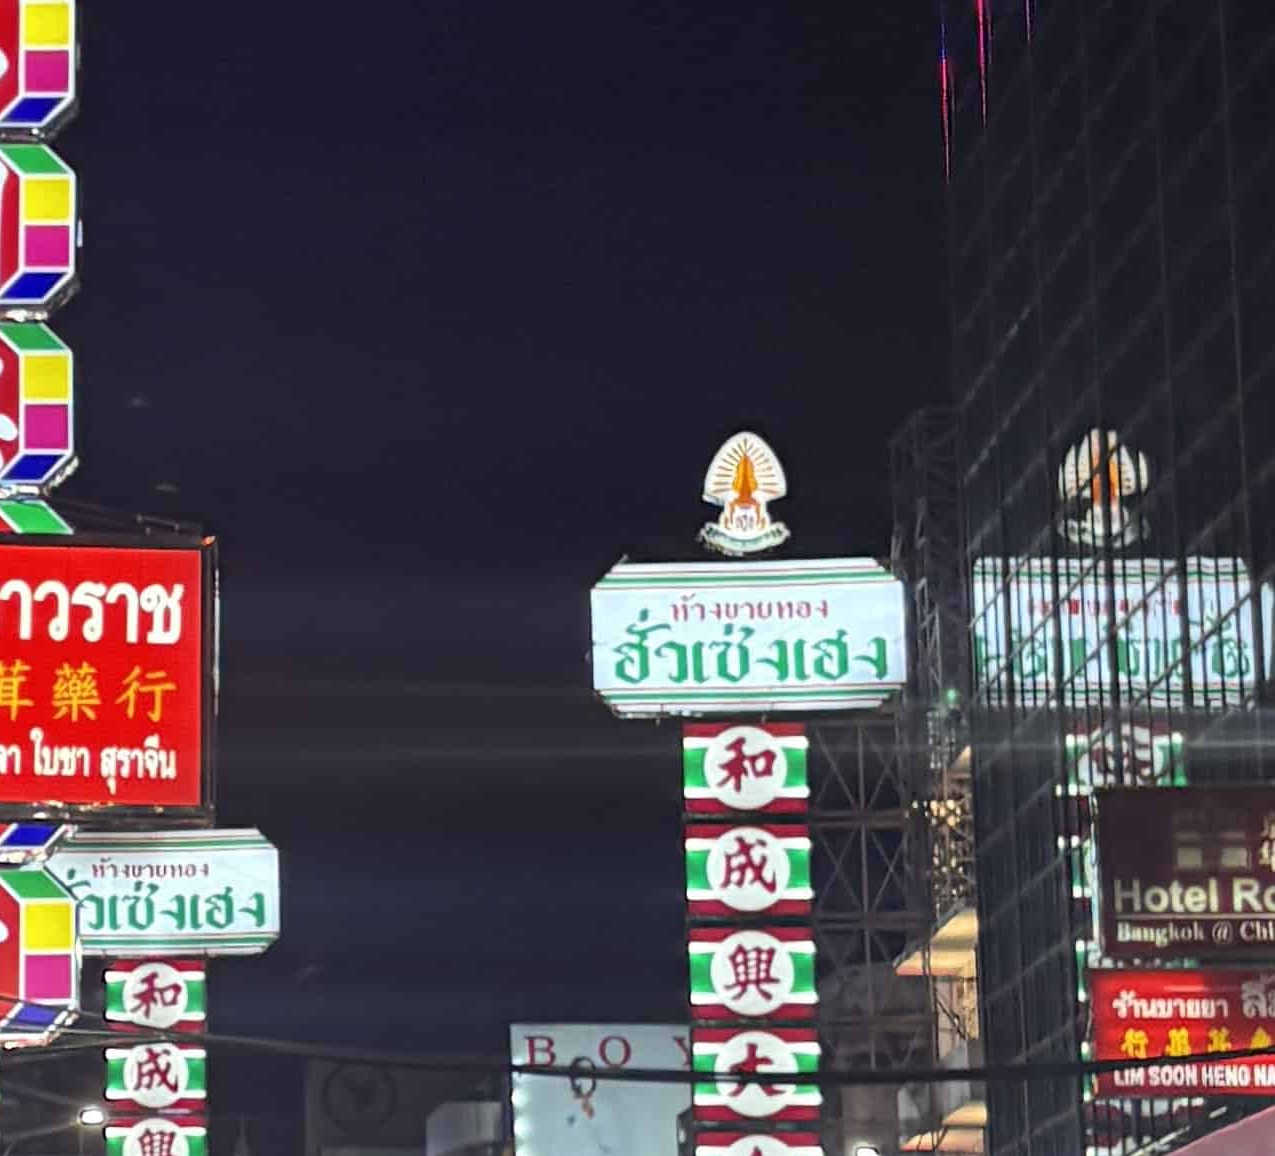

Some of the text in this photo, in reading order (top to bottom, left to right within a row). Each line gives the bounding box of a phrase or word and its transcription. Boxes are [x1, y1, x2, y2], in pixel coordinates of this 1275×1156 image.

[612, 607, 888, 684] ฮั่วเซ่งเฮง
[29, 726, 90, 777] ใบชา
[100, 733, 177, 796] สุราจีน
[67, 867, 266, 930] ั่วเซ่งเฮง
[1114, 877, 1218, 913] Hotel
[1117, 921, 1204, 947] Bangkok
[1113, 1066, 1145, 1086] LIM
[1148, 1065, 1197, 1087] SOON
